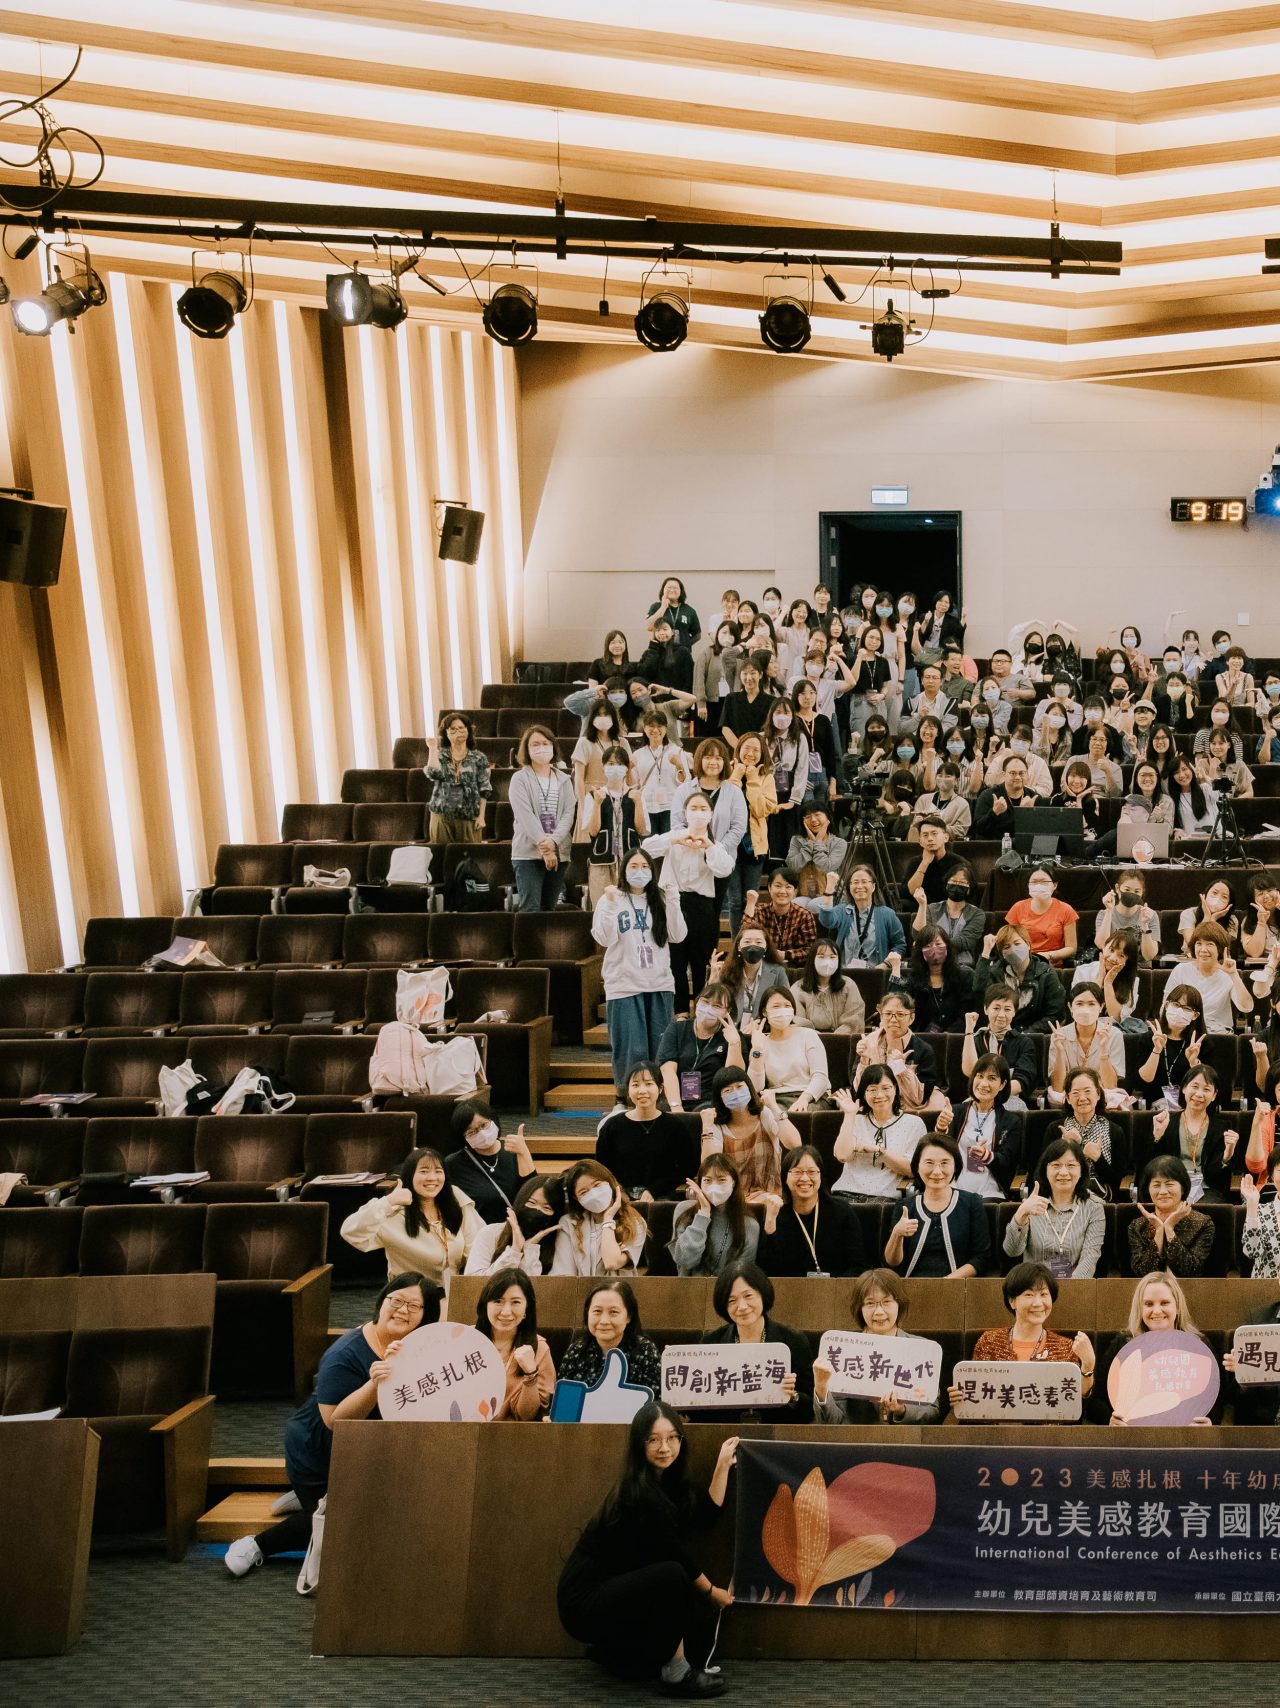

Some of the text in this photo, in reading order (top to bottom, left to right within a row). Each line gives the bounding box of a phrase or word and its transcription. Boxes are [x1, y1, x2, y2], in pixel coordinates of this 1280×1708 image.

[617, 909, 651, 933] GA
[393, 1350, 488, 1410] 美感扎根
[665, 1359, 786, 1396] 開創新藍海
[826, 1345, 934, 1389] 美感新世代
[957, 1377, 1078, 1409] 提升美感素養
[1086, 1468, 1182, 1490] 美感扎根
[975, 1546, 1069, 1559] International
[1078, 1547, 1159, 1560] Conference
[1166, 1547, 1181, 1560] of
[1188, 1547, 1262, 1561] Aesthetics
[1013, 1589, 1157, 1602] 教育部師資培育及藝術教育司
